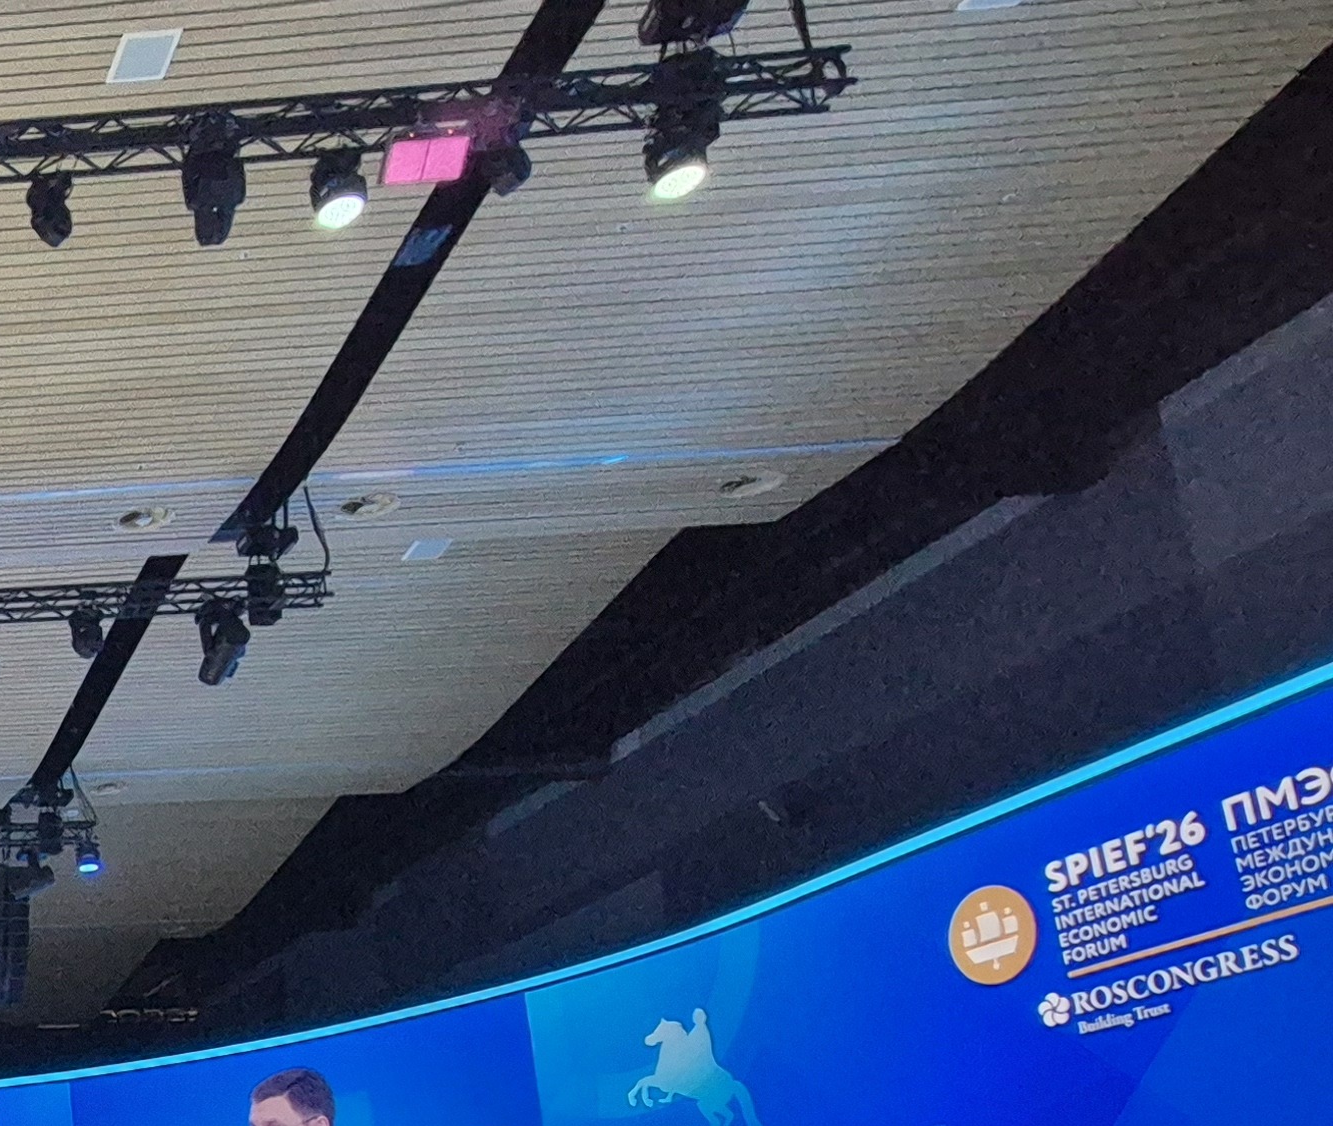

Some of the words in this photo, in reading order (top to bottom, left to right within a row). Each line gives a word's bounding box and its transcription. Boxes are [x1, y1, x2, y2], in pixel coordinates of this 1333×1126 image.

[1221, 766, 1333, 832] ПМЭ
[1044, 810, 1206, 893] SPIEF'26
[1052, 896, 1076, 913] ST.
[1077, 854, 1194, 906] PETERSBURG
[1054, 871, 1206, 931] INTERNATIONAL
[1245, 873, 1329, 910] ФОРУМ
[1058, 905, 1158, 948] ECONOMIC
[1062, 934, 1127, 965] FORUM
[1070, 934, 1299, 1015] ROSCONGRESS
[1077, 1012, 1134, 1035] Building
[1133, 1002, 1171, 1022] Trust
